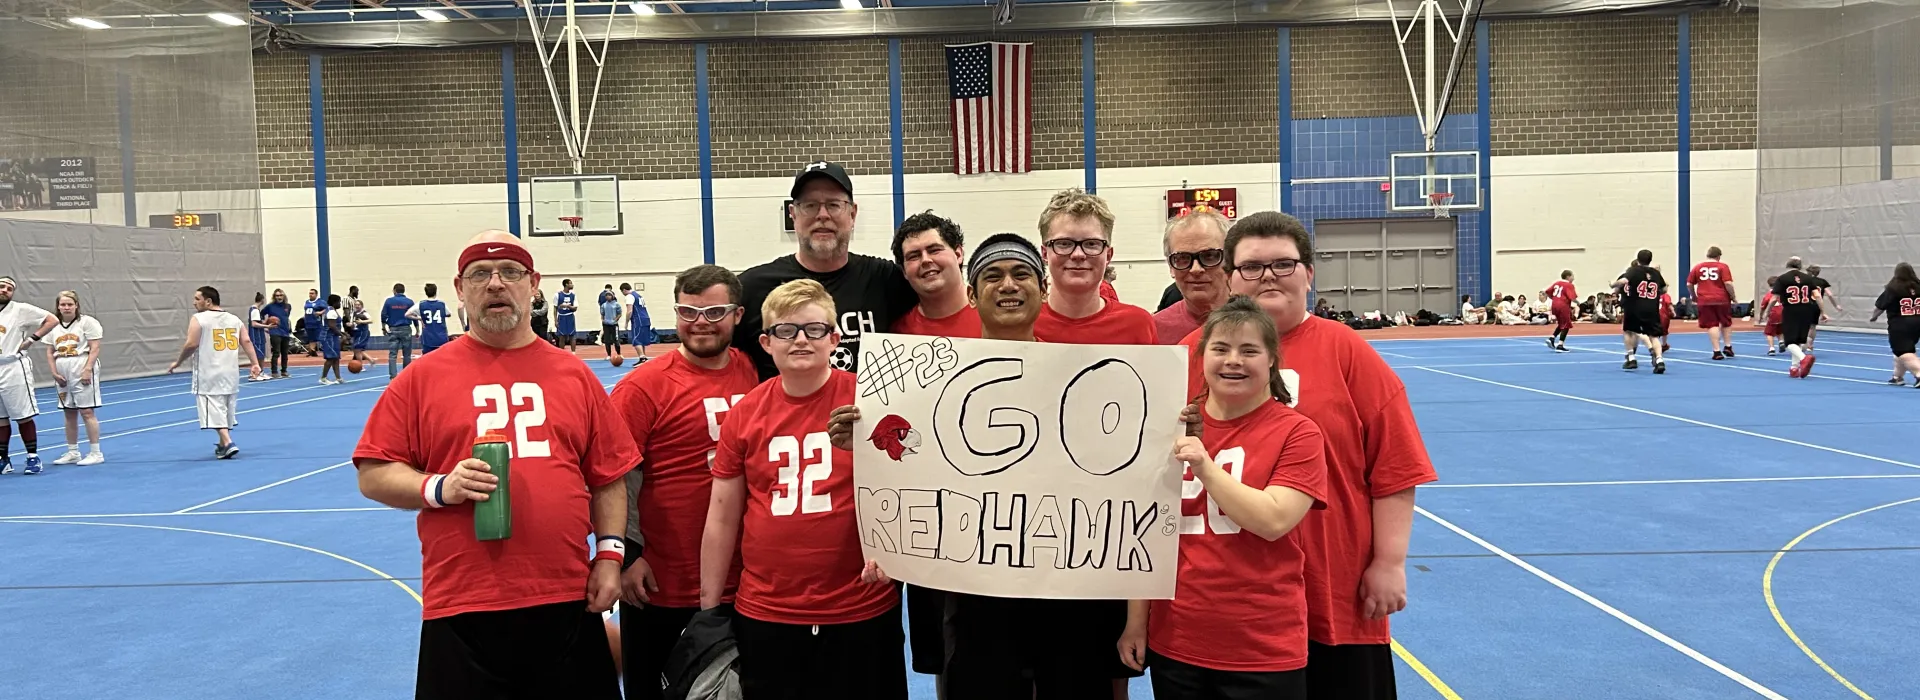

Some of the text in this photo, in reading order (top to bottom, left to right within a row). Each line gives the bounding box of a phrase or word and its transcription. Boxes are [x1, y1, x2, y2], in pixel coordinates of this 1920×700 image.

[60, 159, 83, 167] 2012
[1195, 190, 1219, 201] 1:54
[174, 215, 200, 227] 3:37
[1227, 206, 1235, 217] 6
[1699, 266, 1719, 281] 35
[1636, 280, 1658, 299] 43
[1786, 285, 1809, 304] 31
[423, 309, 442, 324] 34
[212, 327, 239, 351] 55
[857, 337, 958, 405] #23
[472, 382, 551, 459] 22
[933, 357, 1147, 476] GO
[768, 431, 833, 516] 32
